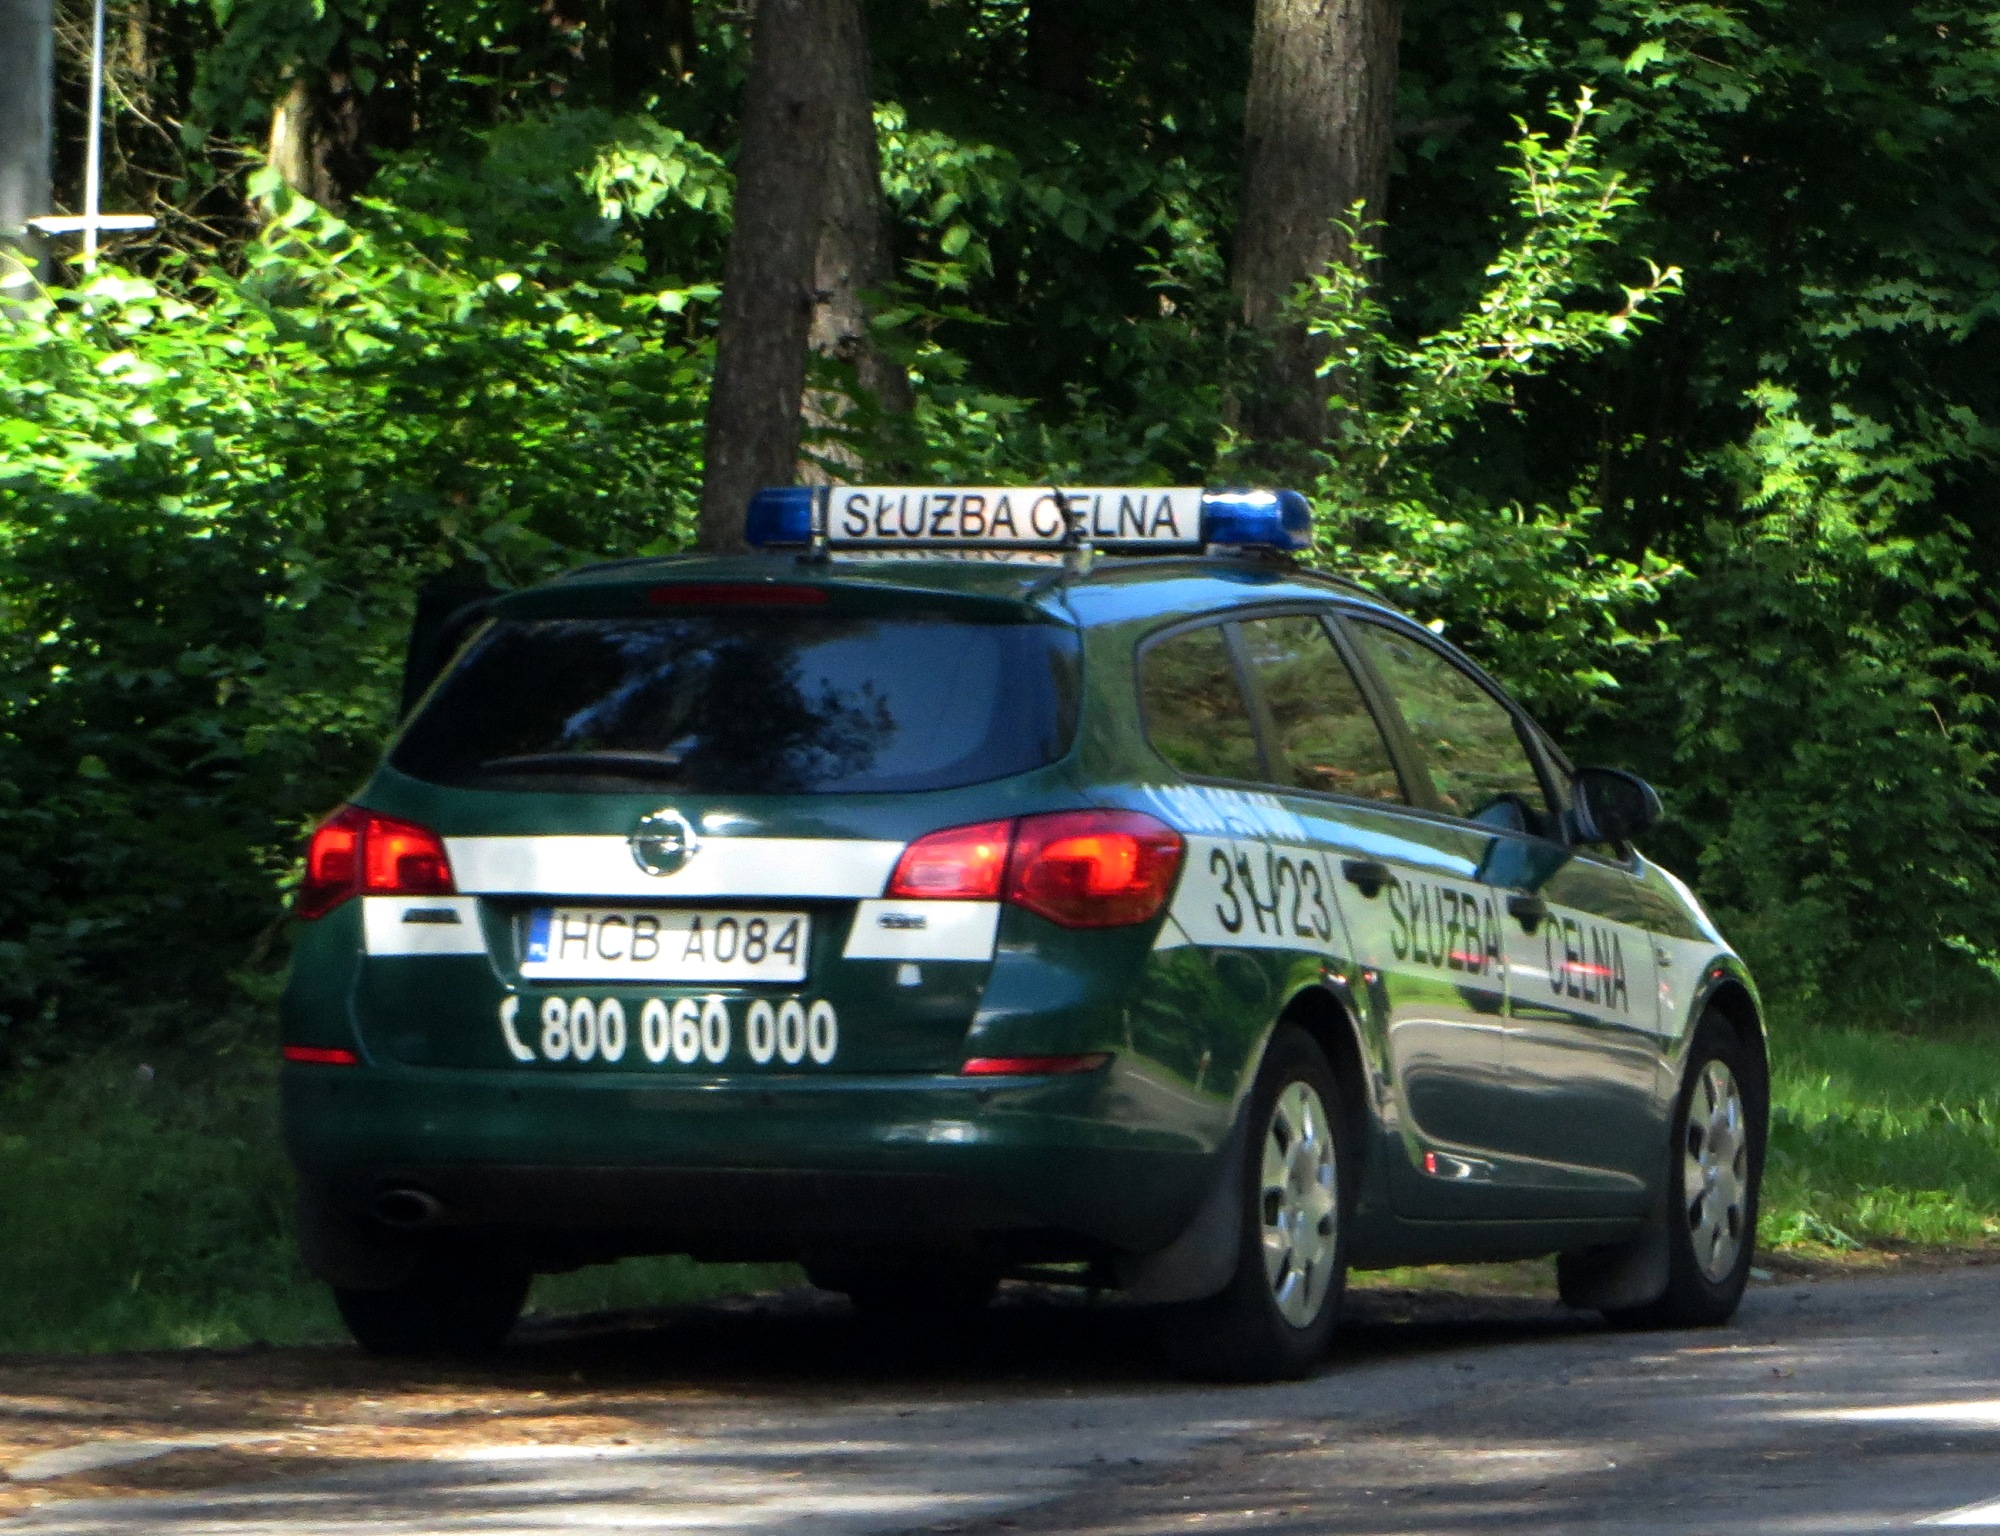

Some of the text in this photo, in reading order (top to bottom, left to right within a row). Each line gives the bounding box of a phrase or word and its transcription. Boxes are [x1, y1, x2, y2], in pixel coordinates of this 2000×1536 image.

[1031, 494, 1179, 537] CELNA
[559, 913, 800, 965] HCB A084
[1546, 911, 1629, 1013] CELNA
[541, 996, 838, 1064] 800 060 000
